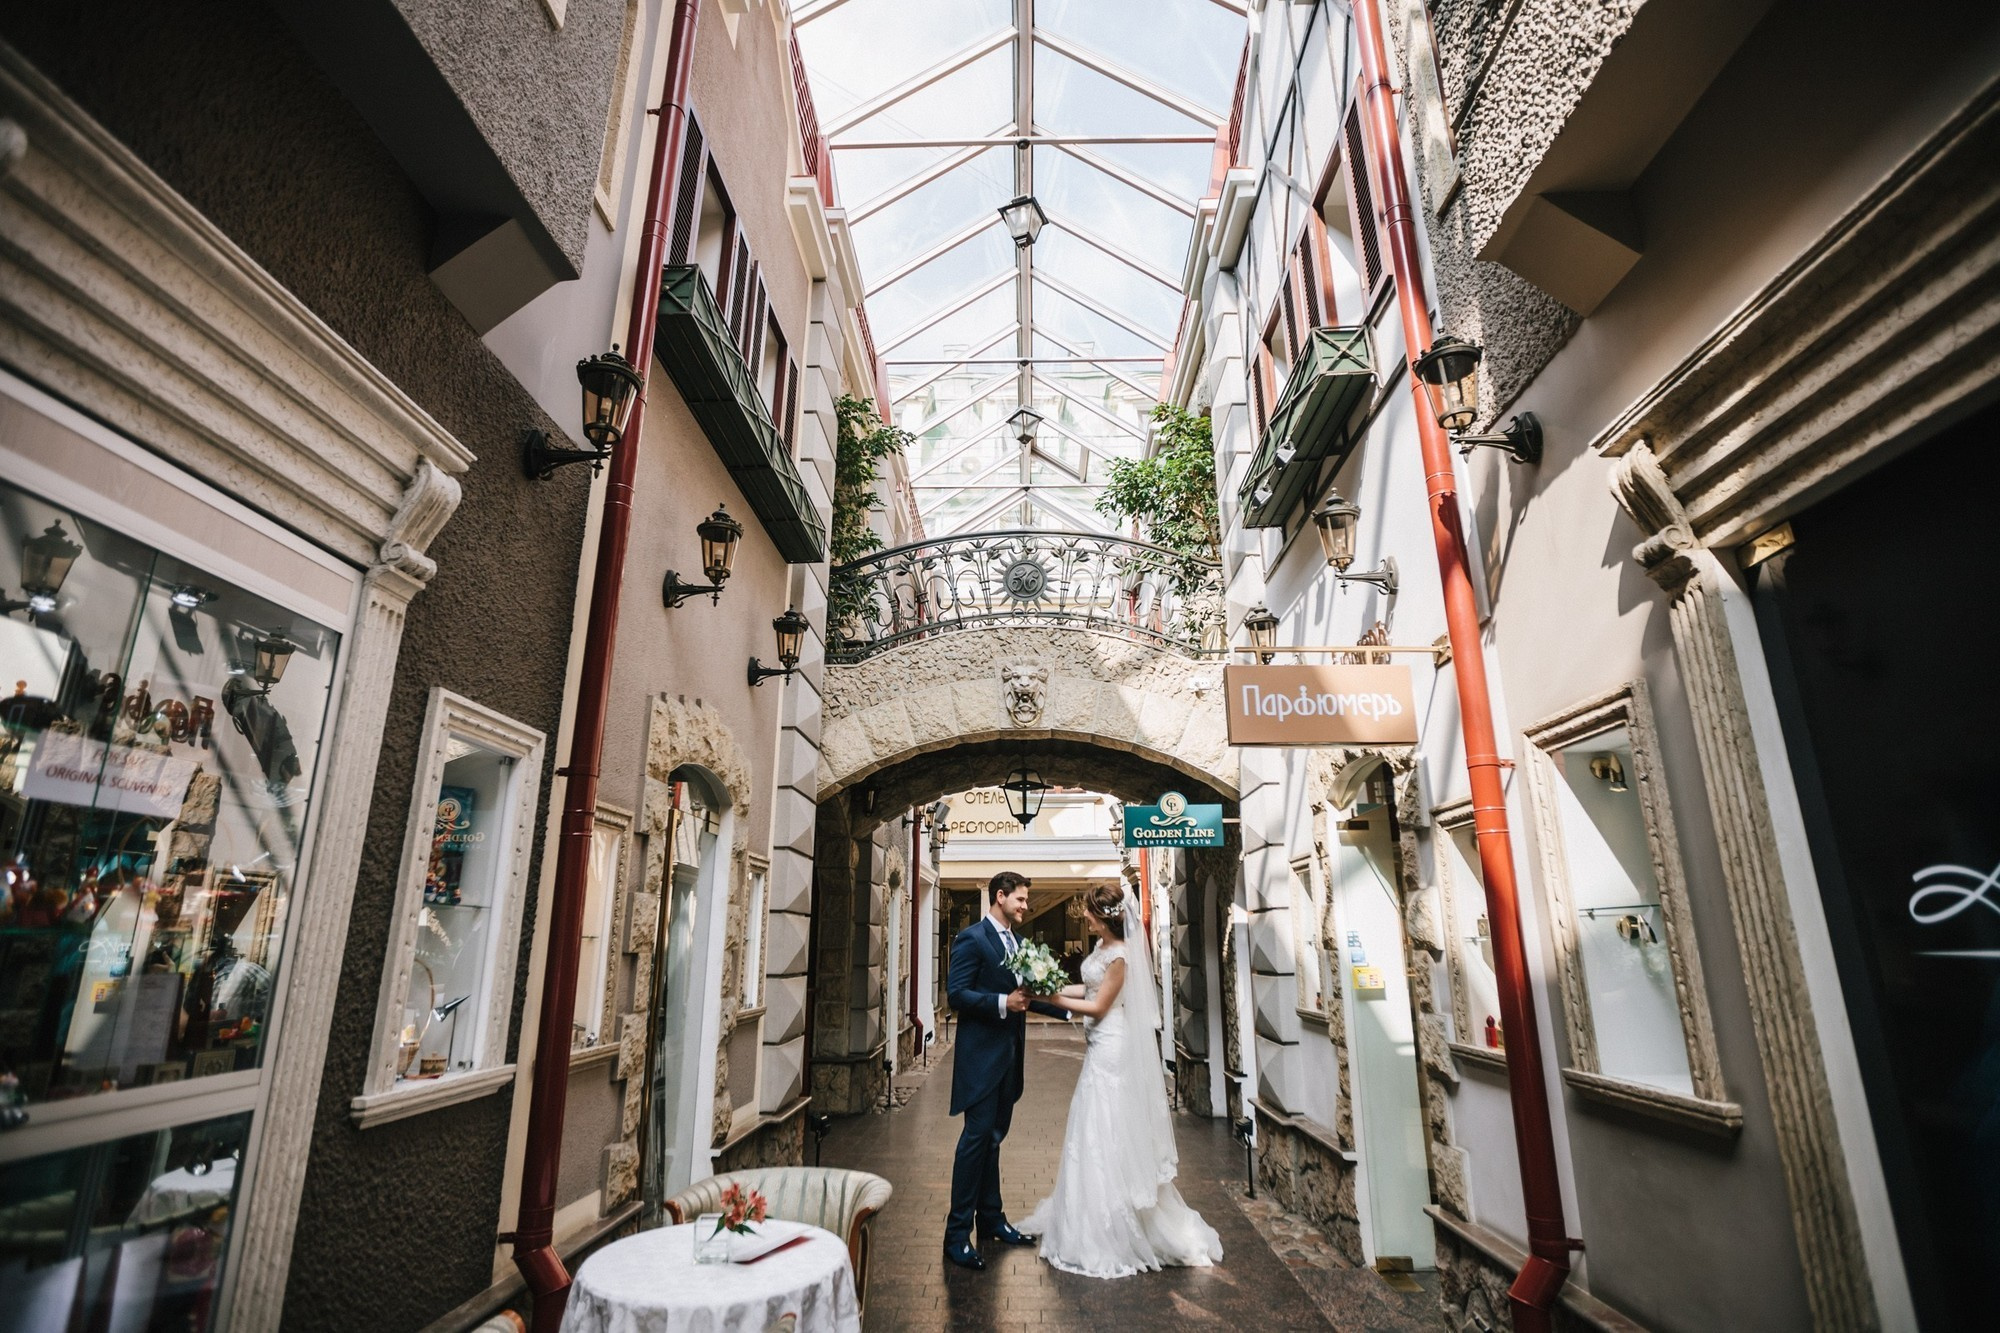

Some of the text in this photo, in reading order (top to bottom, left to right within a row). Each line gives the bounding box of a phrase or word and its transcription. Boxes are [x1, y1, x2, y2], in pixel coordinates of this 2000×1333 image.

[1242, 684, 1403, 722] Парфюмеръ
[45, 764, 107, 786] ORIGINAL
[964, 791, 1006, 805] ОТЕЛЬ
[950, 821, 1020, 834] РЕСТОРАН
[1132, 826, 1216, 839] GOLDEN LINE
